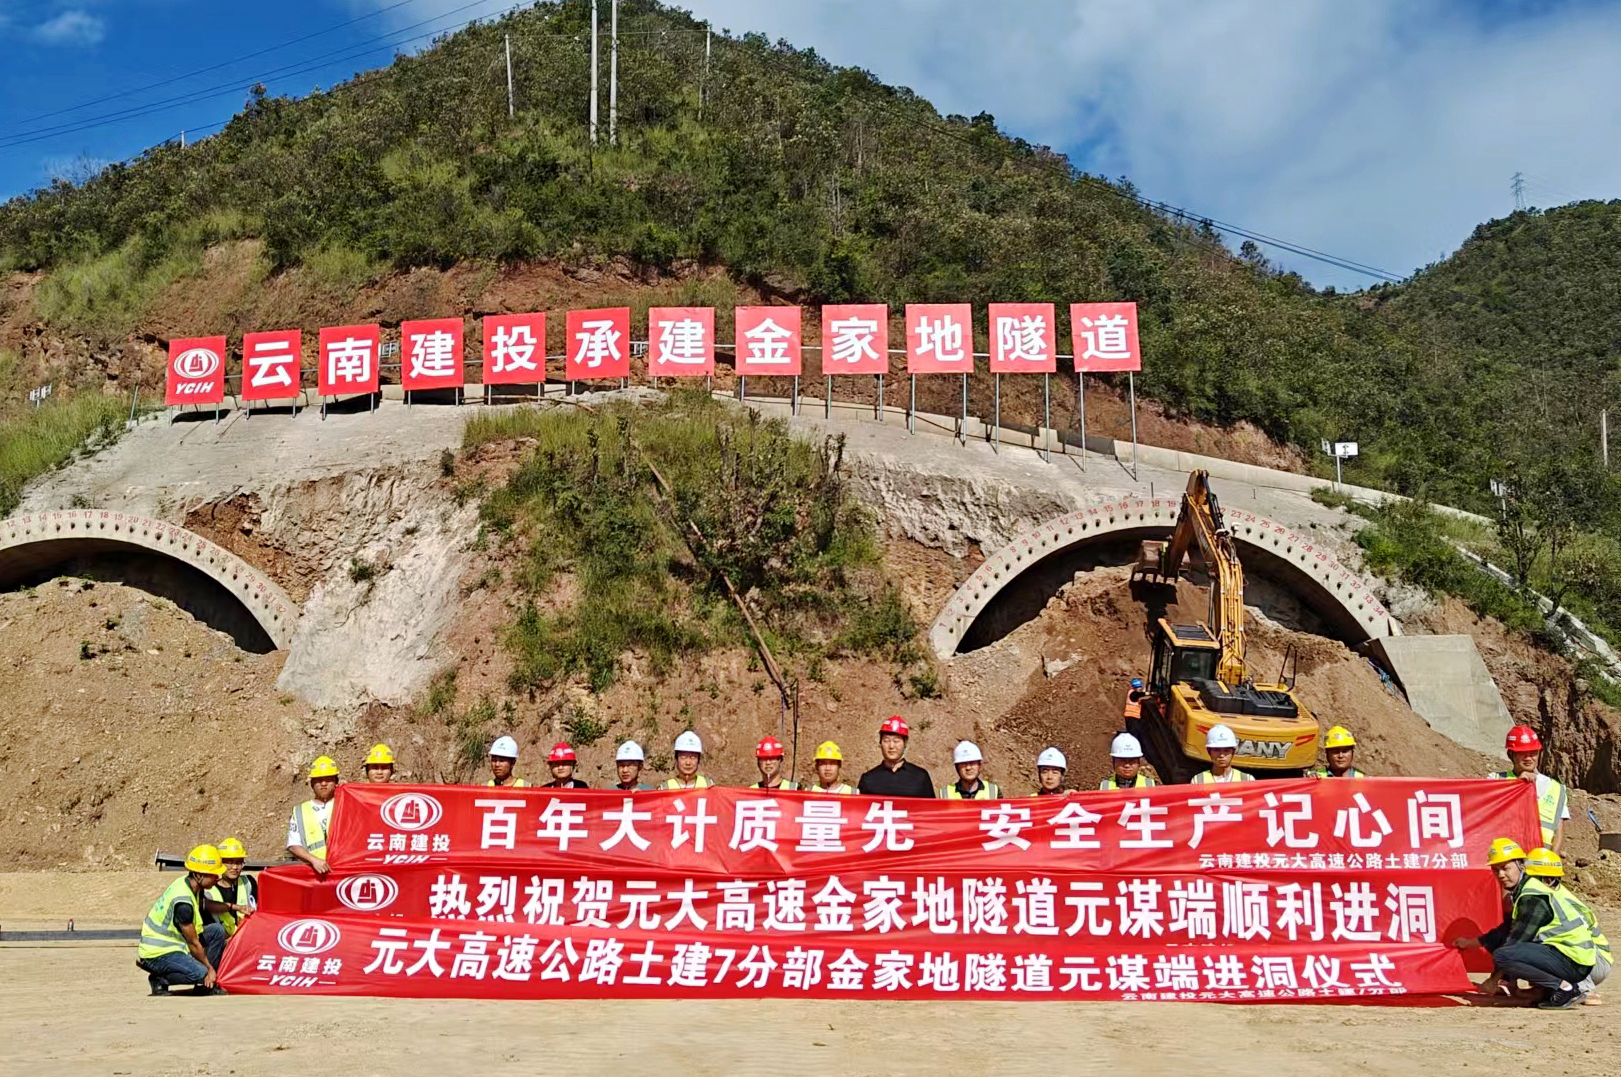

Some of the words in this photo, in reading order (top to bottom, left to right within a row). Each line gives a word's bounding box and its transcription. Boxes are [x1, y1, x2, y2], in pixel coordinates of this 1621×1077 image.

[249, 314, 1132, 388] 云南建投承建金家地隧道
[175, 382, 214, 394] YCIH
[156, 523, 166, 531] 22
[1032, 531, 1041, 539] 10
[1046, 524, 1054, 532] 11
[1060, 517, 1070, 526] 12
[1231, 510, 1241, 519] 23
[1245, 514, 1256, 523] 24
[1260, 520, 1270, 528] 25
[1274, 526, 1285, 534] 26
[1288, 534, 1299, 542] 27
[1301, 542, 1313, 552] 28
[1315, 552, 1327, 561] 29
[1328, 561, 1339, 571] 30
[1340, 570, 1350, 580] 31
[1350, 580, 1361, 589] 32
[1363, 593, 1374, 604] 33
[1373, 606, 1384, 616] 34
[1236, 738, 1292, 758] ANY
[475, 798, 914, 853] 百年大计质量先
[979, 790, 1464, 851] 安全生产记心间
[367, 833, 450, 852] 云南建投
[383, 854, 430, 864] YCIH
[1199, 852, 1468, 869] 云南建投元大高速公路土建7分部
[429, 874, 1437, 943] 热烈祝贺元大高速金家地隧道元谋端顺利进洞
[257, 955, 342, 975] 云南建投
[363, 928, 1403, 992] 元大高速公路土建7分部金家地隧道元谋端进洞仪式
[269, 974, 318, 987] YCIH
